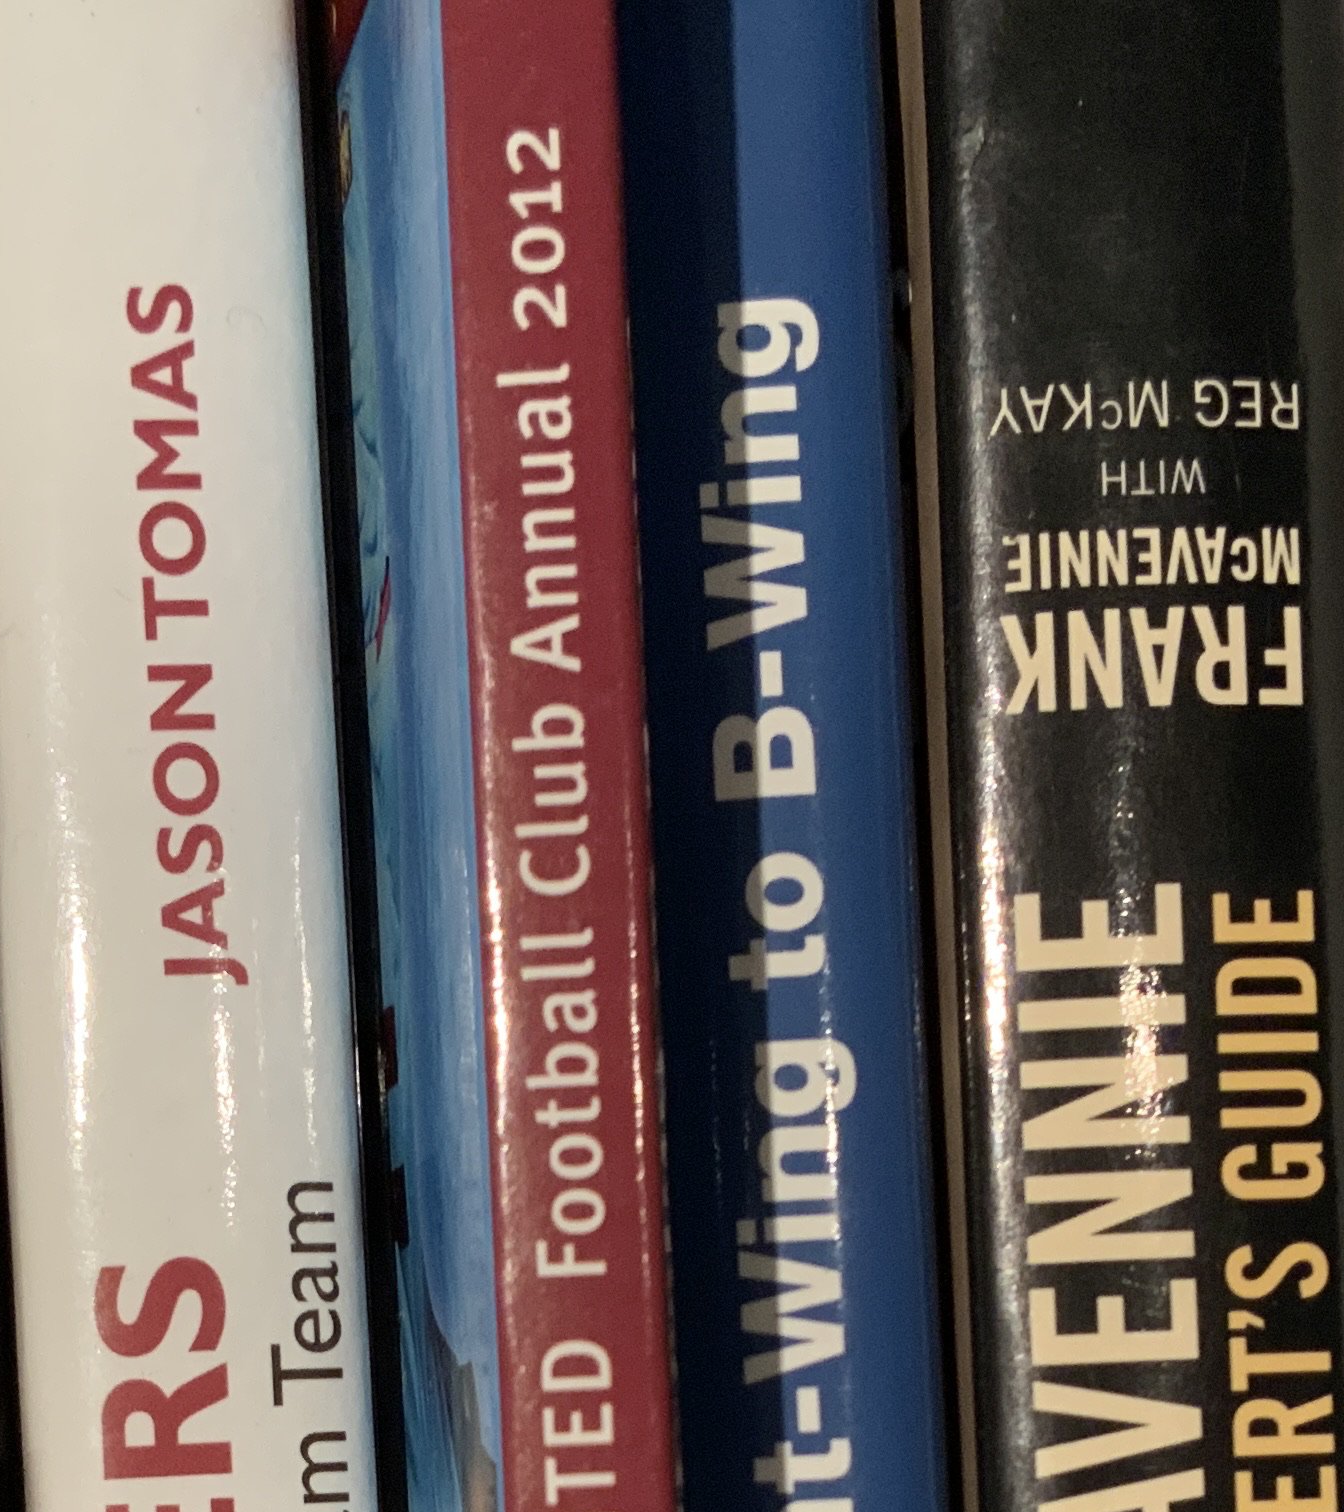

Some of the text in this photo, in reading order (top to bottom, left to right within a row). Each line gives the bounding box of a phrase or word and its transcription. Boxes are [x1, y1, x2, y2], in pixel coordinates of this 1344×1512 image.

[506, 126, 567, 330] 2012
[1100, 458, 1205, 496] WITH
[1193, 377, 1300, 430] REG
[497, 363, 582, 673] Annual
[699, 296, 818, 801] B-Wing
[126, 283, 248, 986] JASON TOMAS
[1000, 606, 1304, 716] FRANK
[512, 701, 591, 898] Club
[729, 850, 828, 982] to
[522, 928, 609, 1278] Football
[1212, 889, 1328, 1201] GUIDE
[272, 1179, 342, 1408] Team
